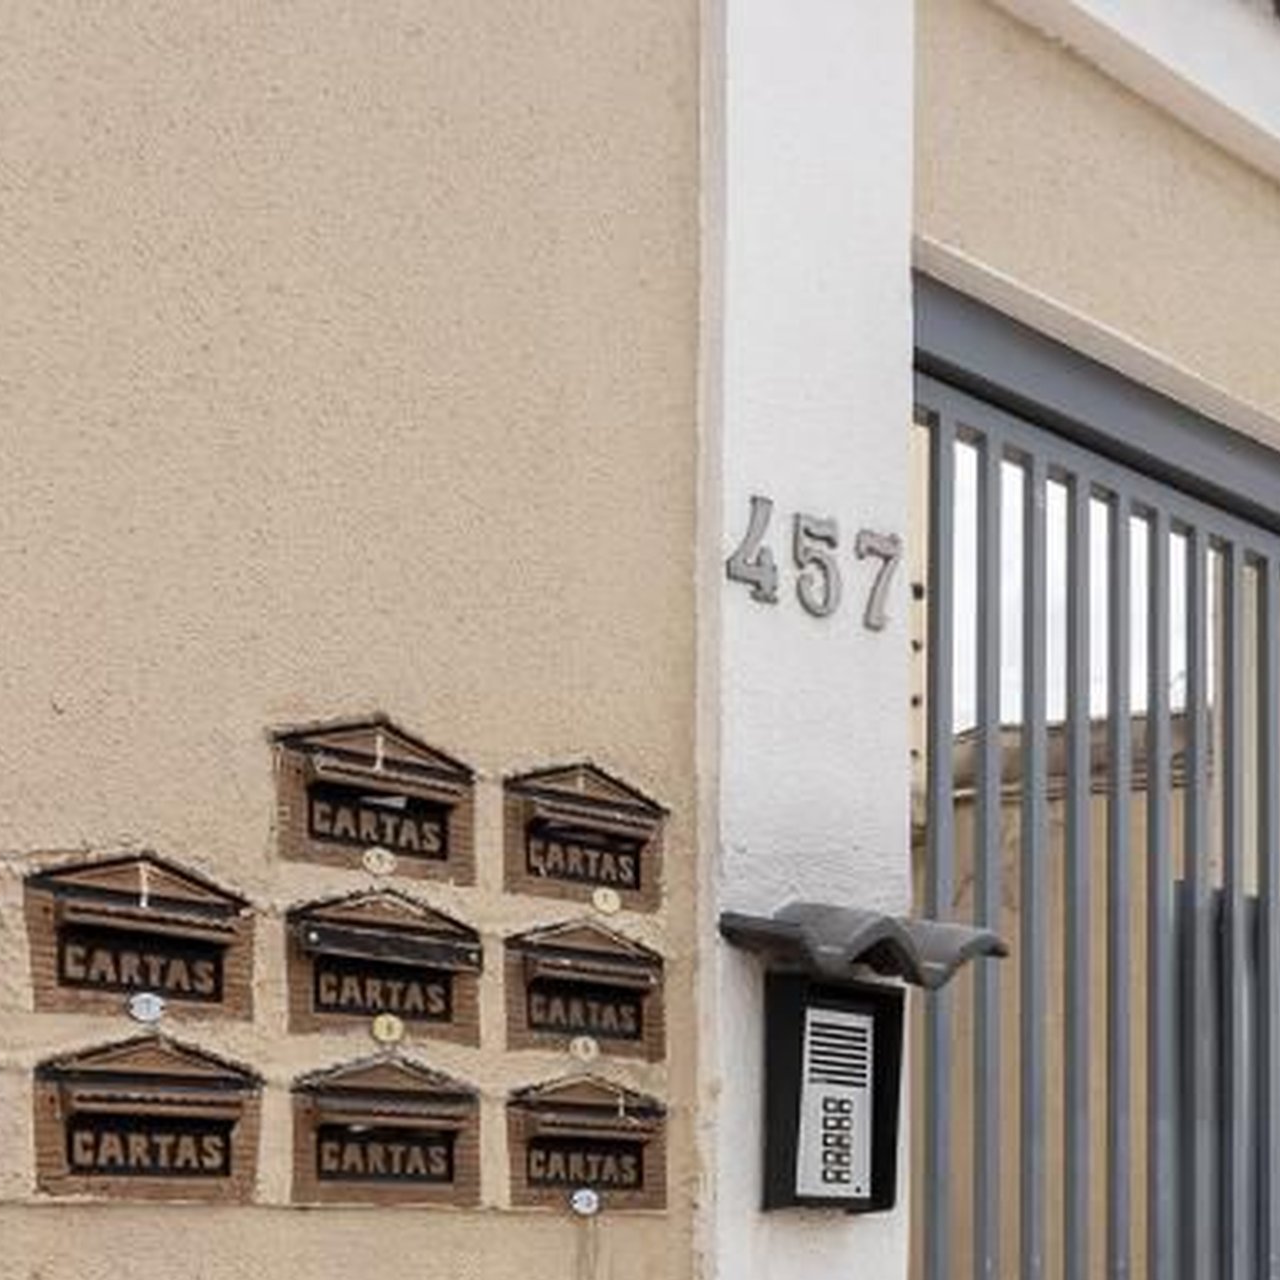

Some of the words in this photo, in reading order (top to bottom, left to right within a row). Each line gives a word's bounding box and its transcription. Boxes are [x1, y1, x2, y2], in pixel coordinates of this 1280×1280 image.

[726, 495, 902, 632] 457
[312, 802, 442, 852] CARTAS
[528, 838, 635, 885] CARTAS
[63, 943, 216, 995] CARTAS
[322, 973, 446, 1015] CARTAS
[529, 997, 637, 1034] CARTAS
[72, 1130, 224, 1168] CARTAS
[323, 1142, 448, 1177] CARTAS
[530, 1149, 638, 1184] CARTAS
